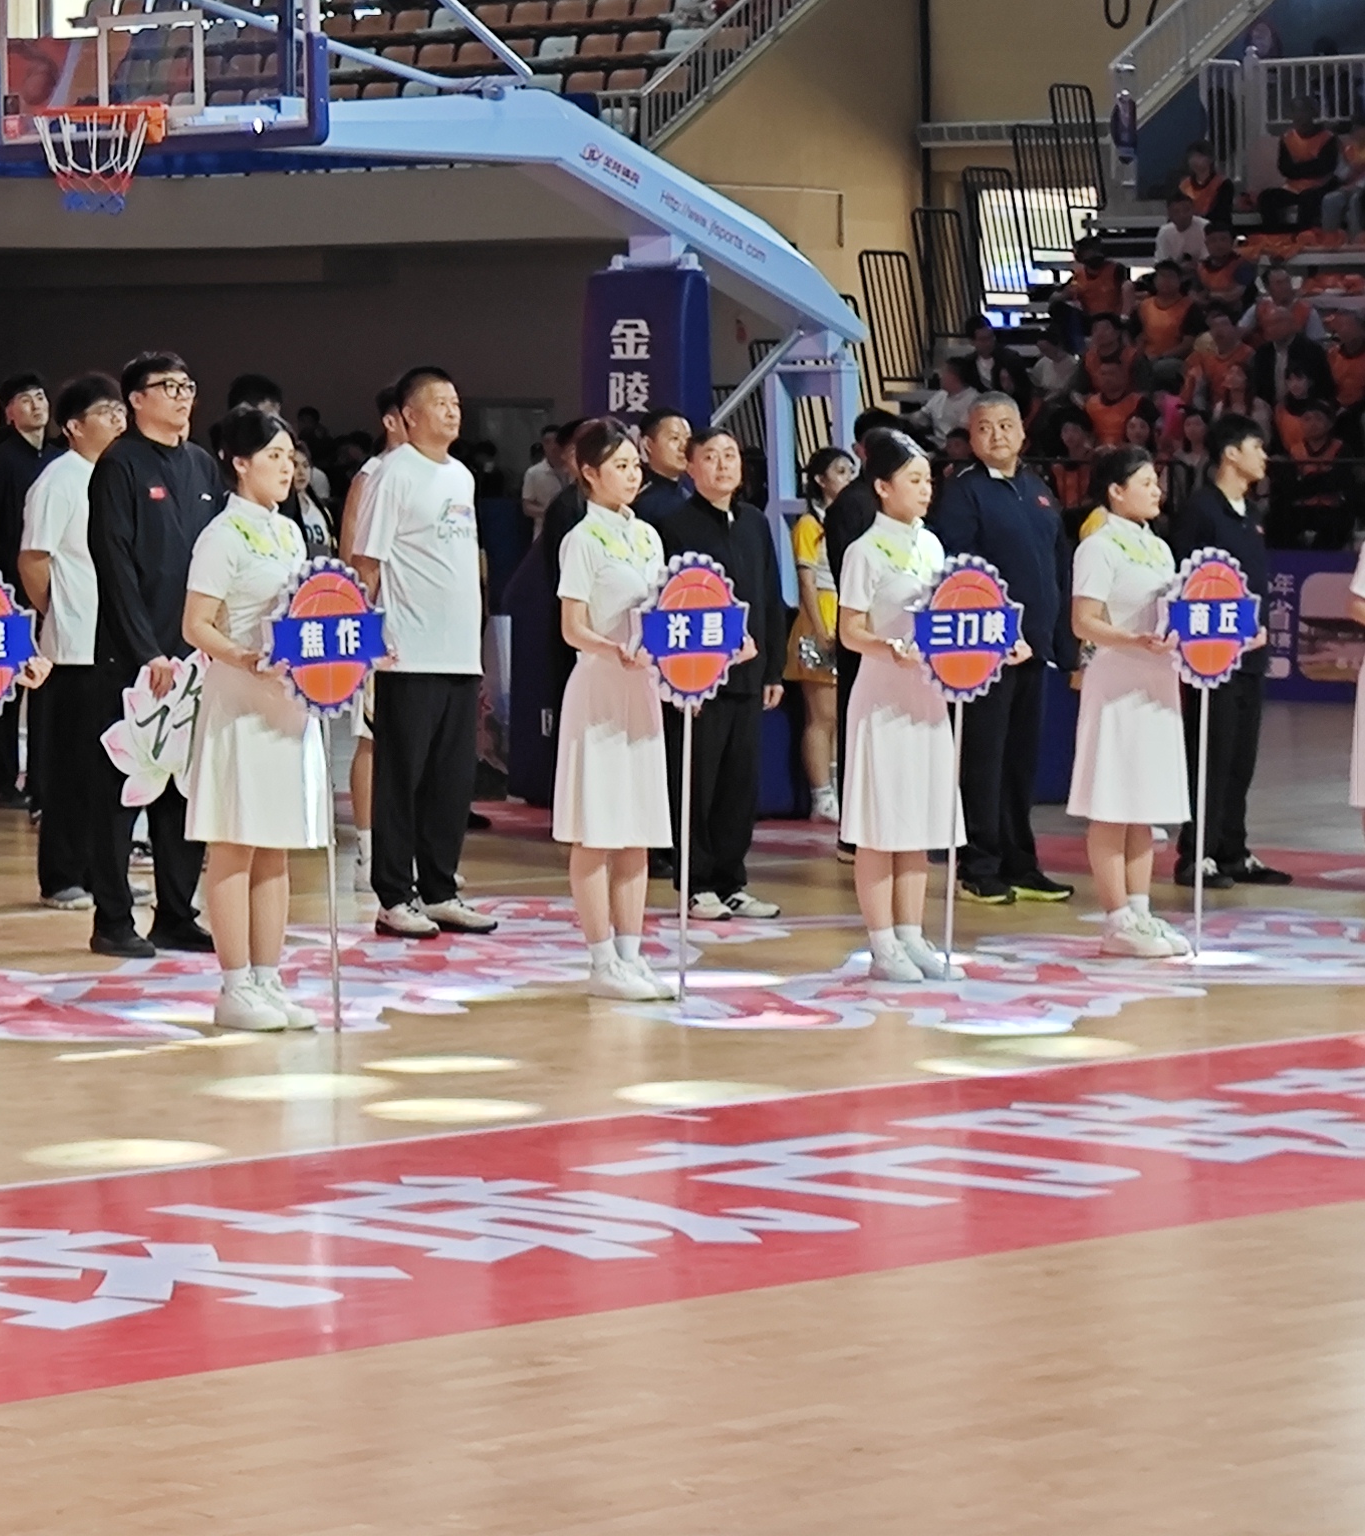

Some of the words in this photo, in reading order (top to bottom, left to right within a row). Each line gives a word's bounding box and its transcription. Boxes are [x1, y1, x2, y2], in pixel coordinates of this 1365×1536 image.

[667, 613, 724, 649] 许昌
[928, 612, 1006, 646] 三门峡
[1188, 602, 1239, 635] 商丘
[300, 619, 361, 658] 焦作
